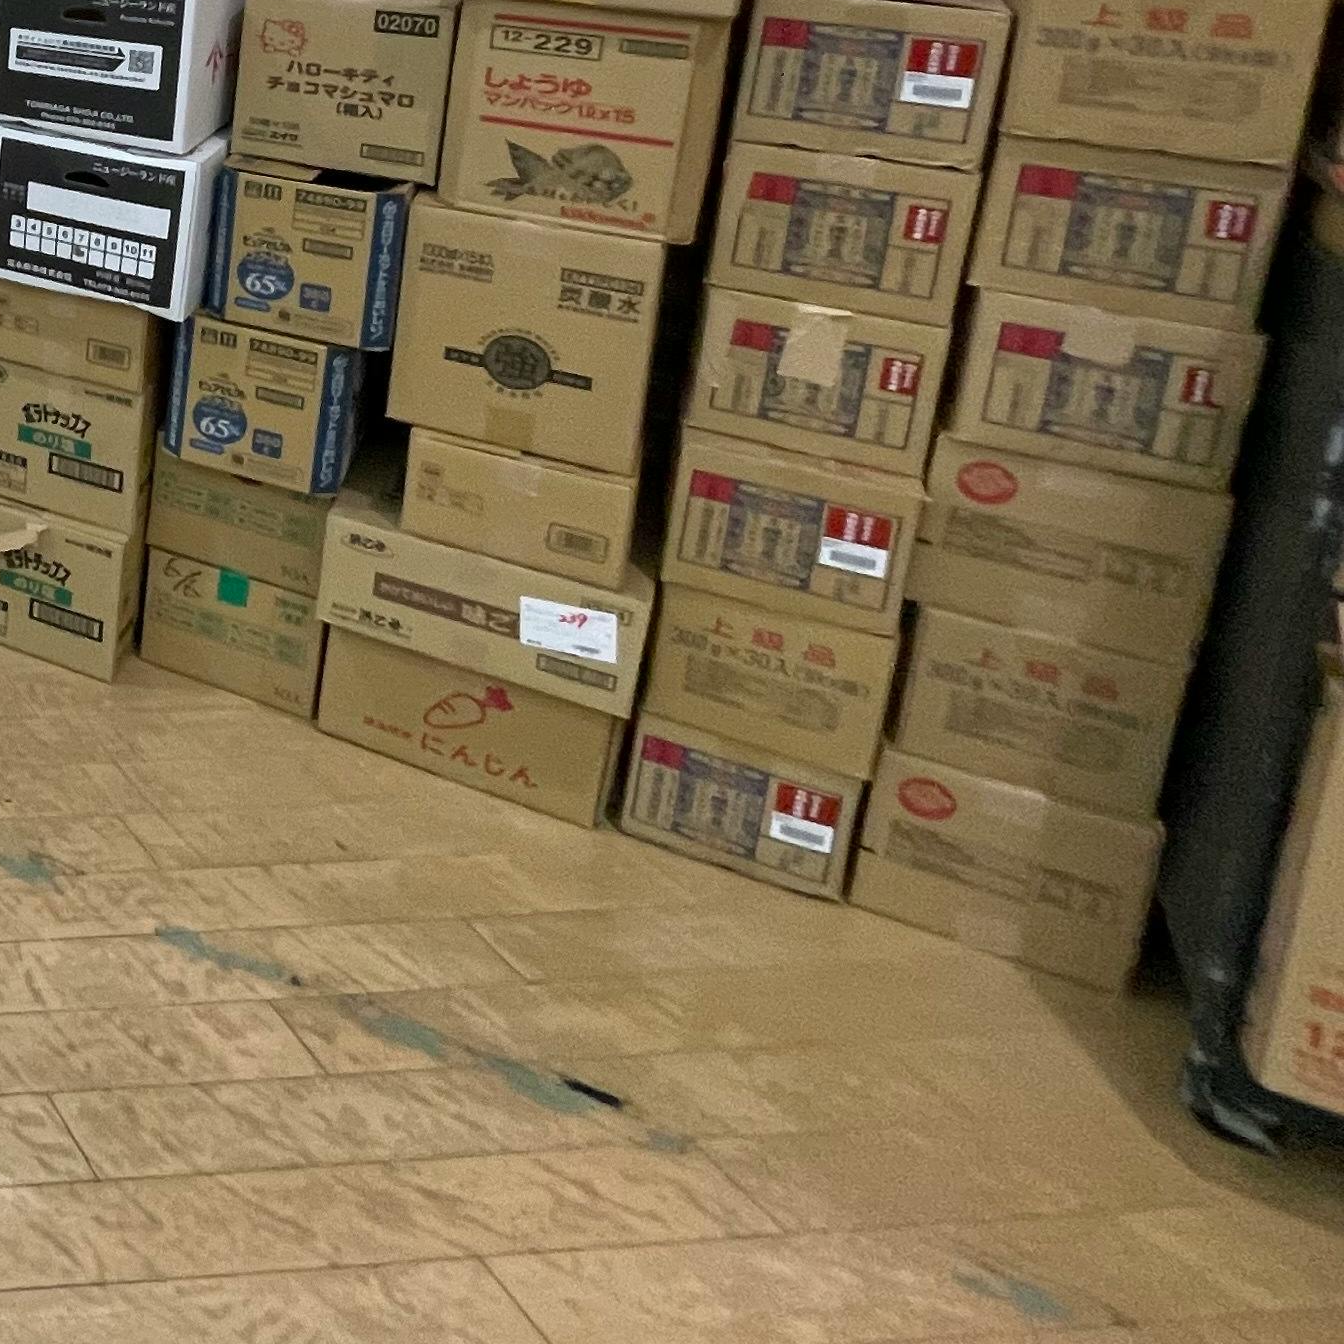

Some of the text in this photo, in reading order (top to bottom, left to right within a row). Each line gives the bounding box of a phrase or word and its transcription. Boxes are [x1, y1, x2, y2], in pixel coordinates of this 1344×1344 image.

[377, 14, 438, 36] 02070
[502, 30, 593, 56] 12-229
[286, 59, 395, 87] ハローキティ
[484, 66, 593, 98] しょうゆ
[267, 76, 415, 108] チョコマシュマロ
[419, 733, 539, 789] にんじん
